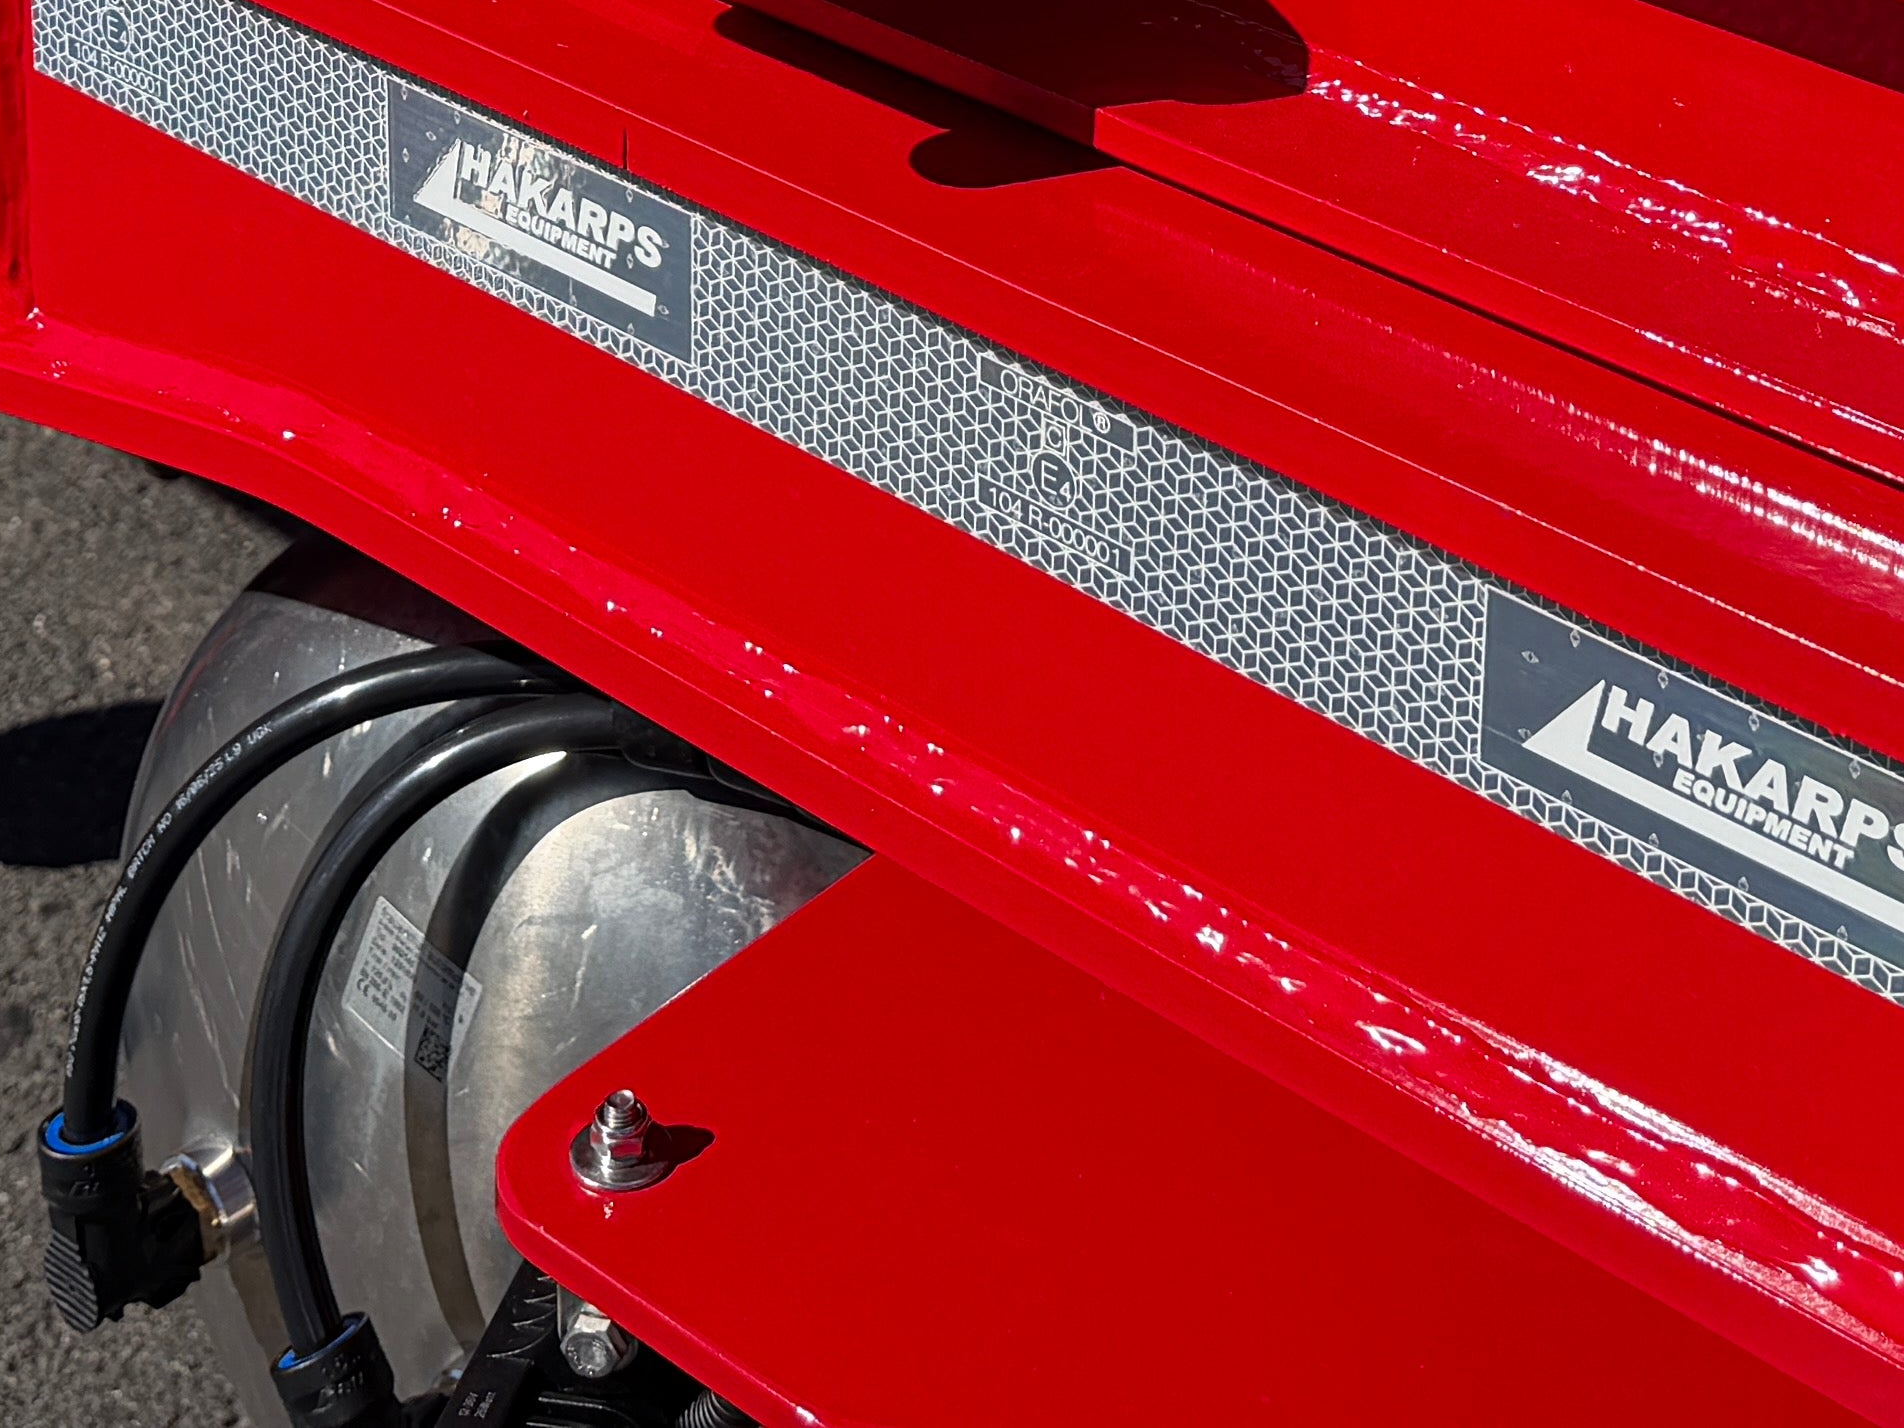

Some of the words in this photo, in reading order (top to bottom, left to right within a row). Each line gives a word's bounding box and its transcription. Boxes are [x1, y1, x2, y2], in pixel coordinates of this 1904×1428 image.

[74, 43, 97, 66] 104
[461, 143, 664, 268] HAKARPS
[506, 204, 617, 269] EQUIPMENT
[1046, 425, 1062, 448] C
[989, 487, 1023, 520] 104
[1029, 505, 1120, 570] R-00001
[1672, 768, 1854, 871] EQUIPMENT
